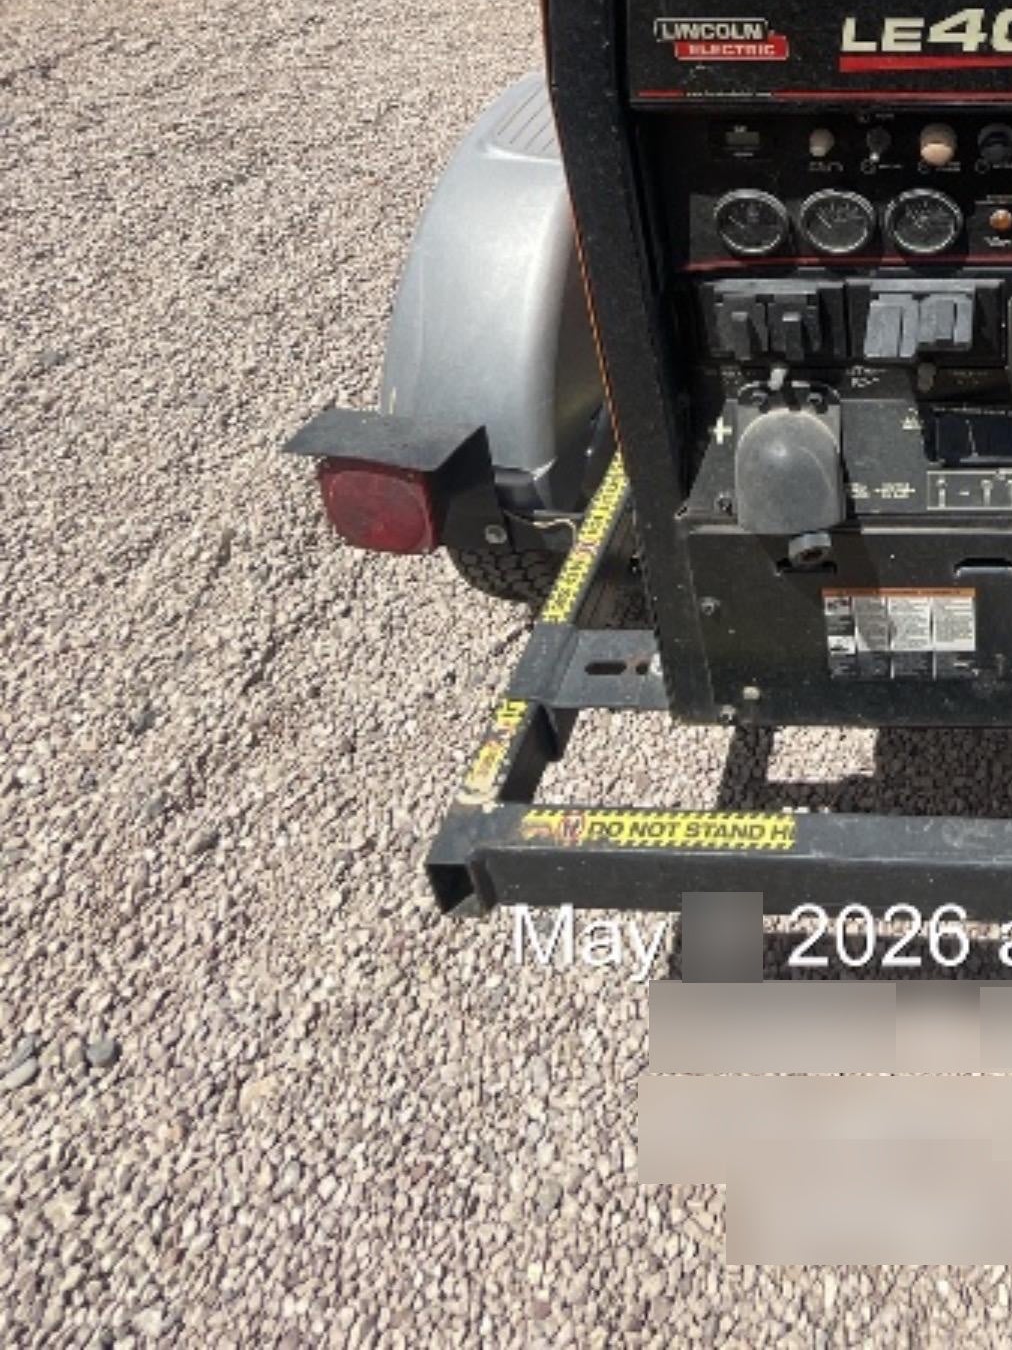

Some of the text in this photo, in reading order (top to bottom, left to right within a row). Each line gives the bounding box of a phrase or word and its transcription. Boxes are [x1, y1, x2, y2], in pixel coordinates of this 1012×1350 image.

[661, 23, 763, 41] LINCOLN
[689, 44, 775, 56] ELECTRIC
[589, 822, 794, 840] DO NOT STAND H
